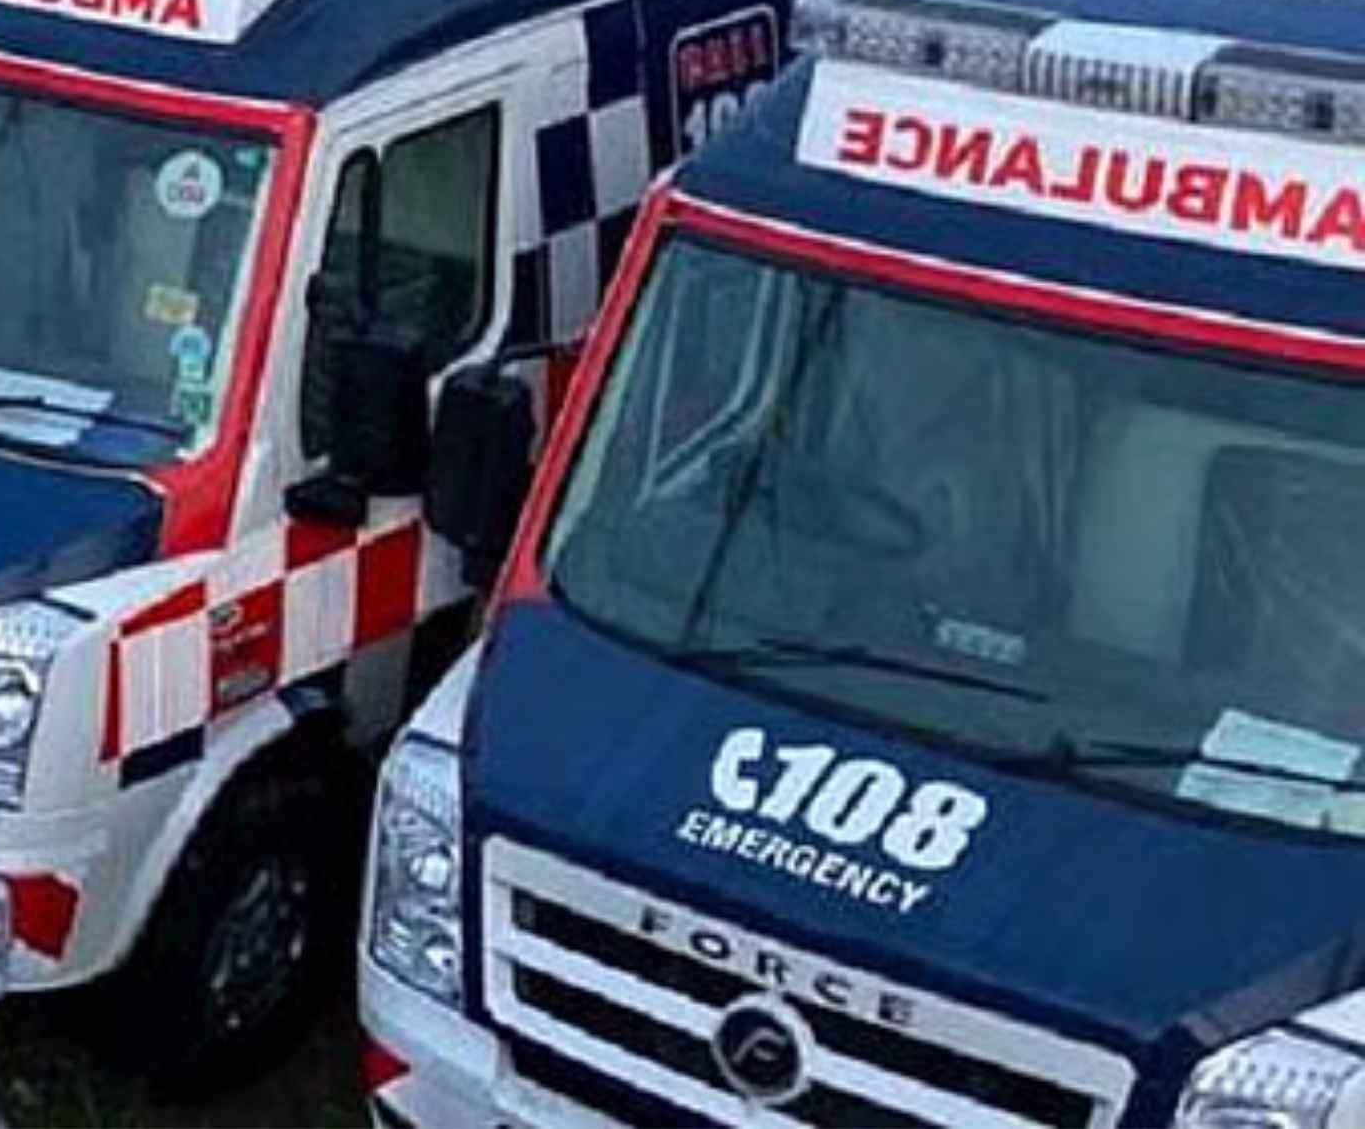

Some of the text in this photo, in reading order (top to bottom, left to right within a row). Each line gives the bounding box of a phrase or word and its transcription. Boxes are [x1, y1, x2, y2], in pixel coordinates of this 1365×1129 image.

[676, 808, 933, 914] EMERGENCY
[757, 742, 988, 871] 108
[639, 905, 918, 1026] FORCE
